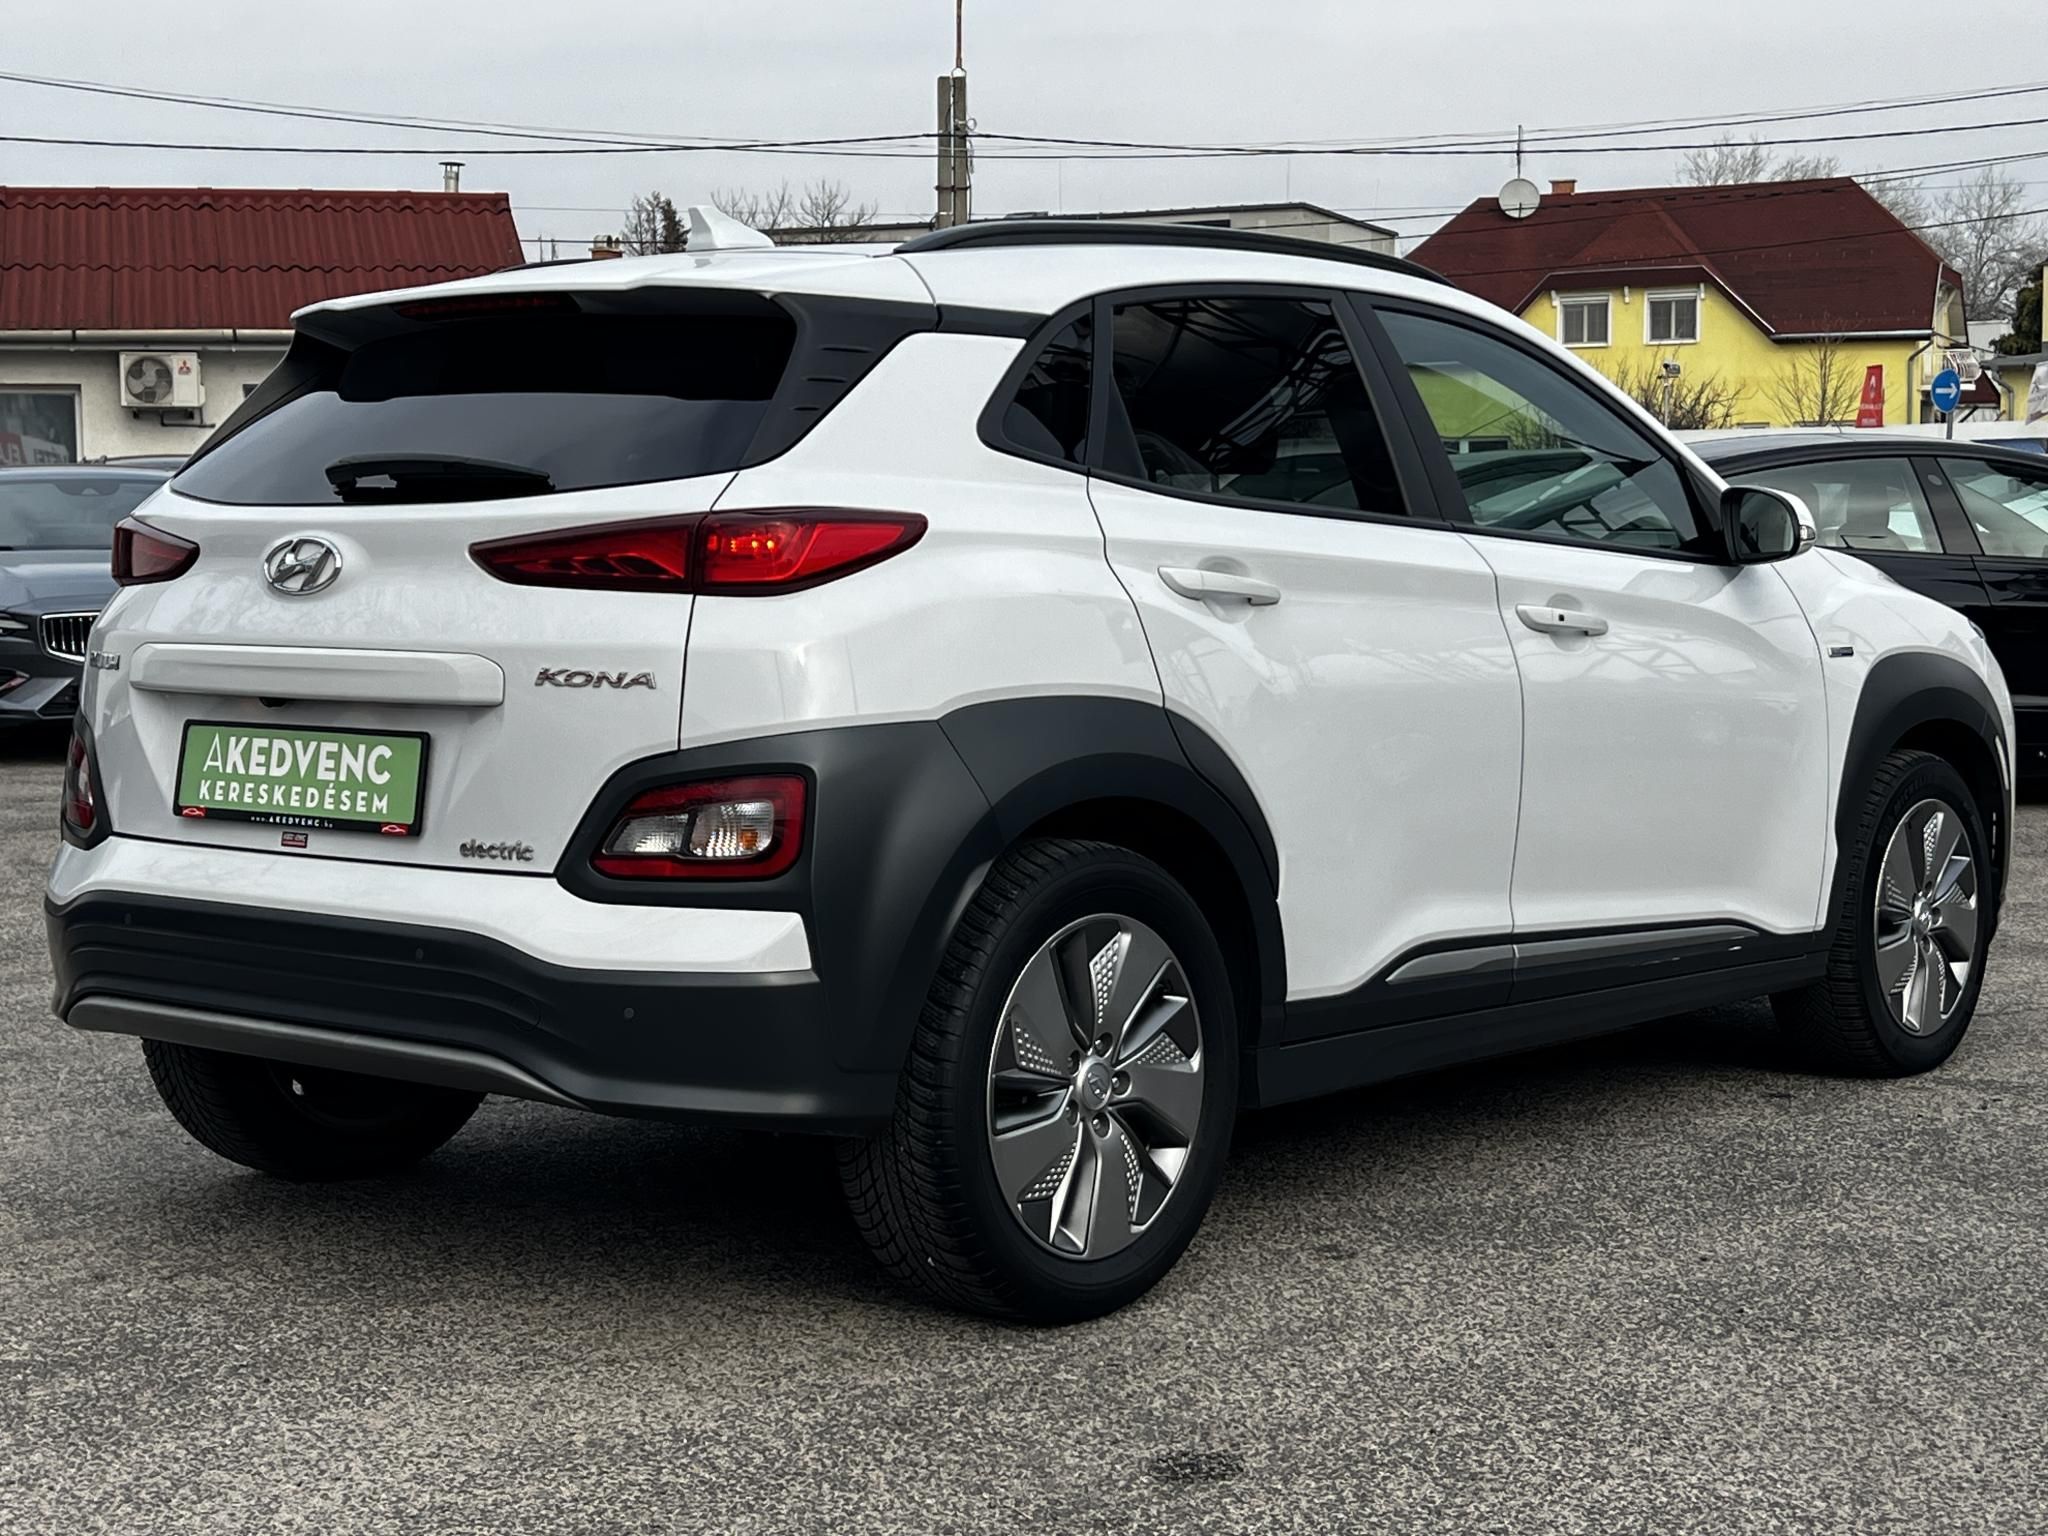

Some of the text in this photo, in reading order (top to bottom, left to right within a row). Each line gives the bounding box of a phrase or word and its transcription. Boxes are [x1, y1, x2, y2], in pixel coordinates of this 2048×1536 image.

[534, 667, 657, 690] KONA
[198, 779, 389, 814] KERESKEDÉSEM
[459, 839, 535, 862] electric
